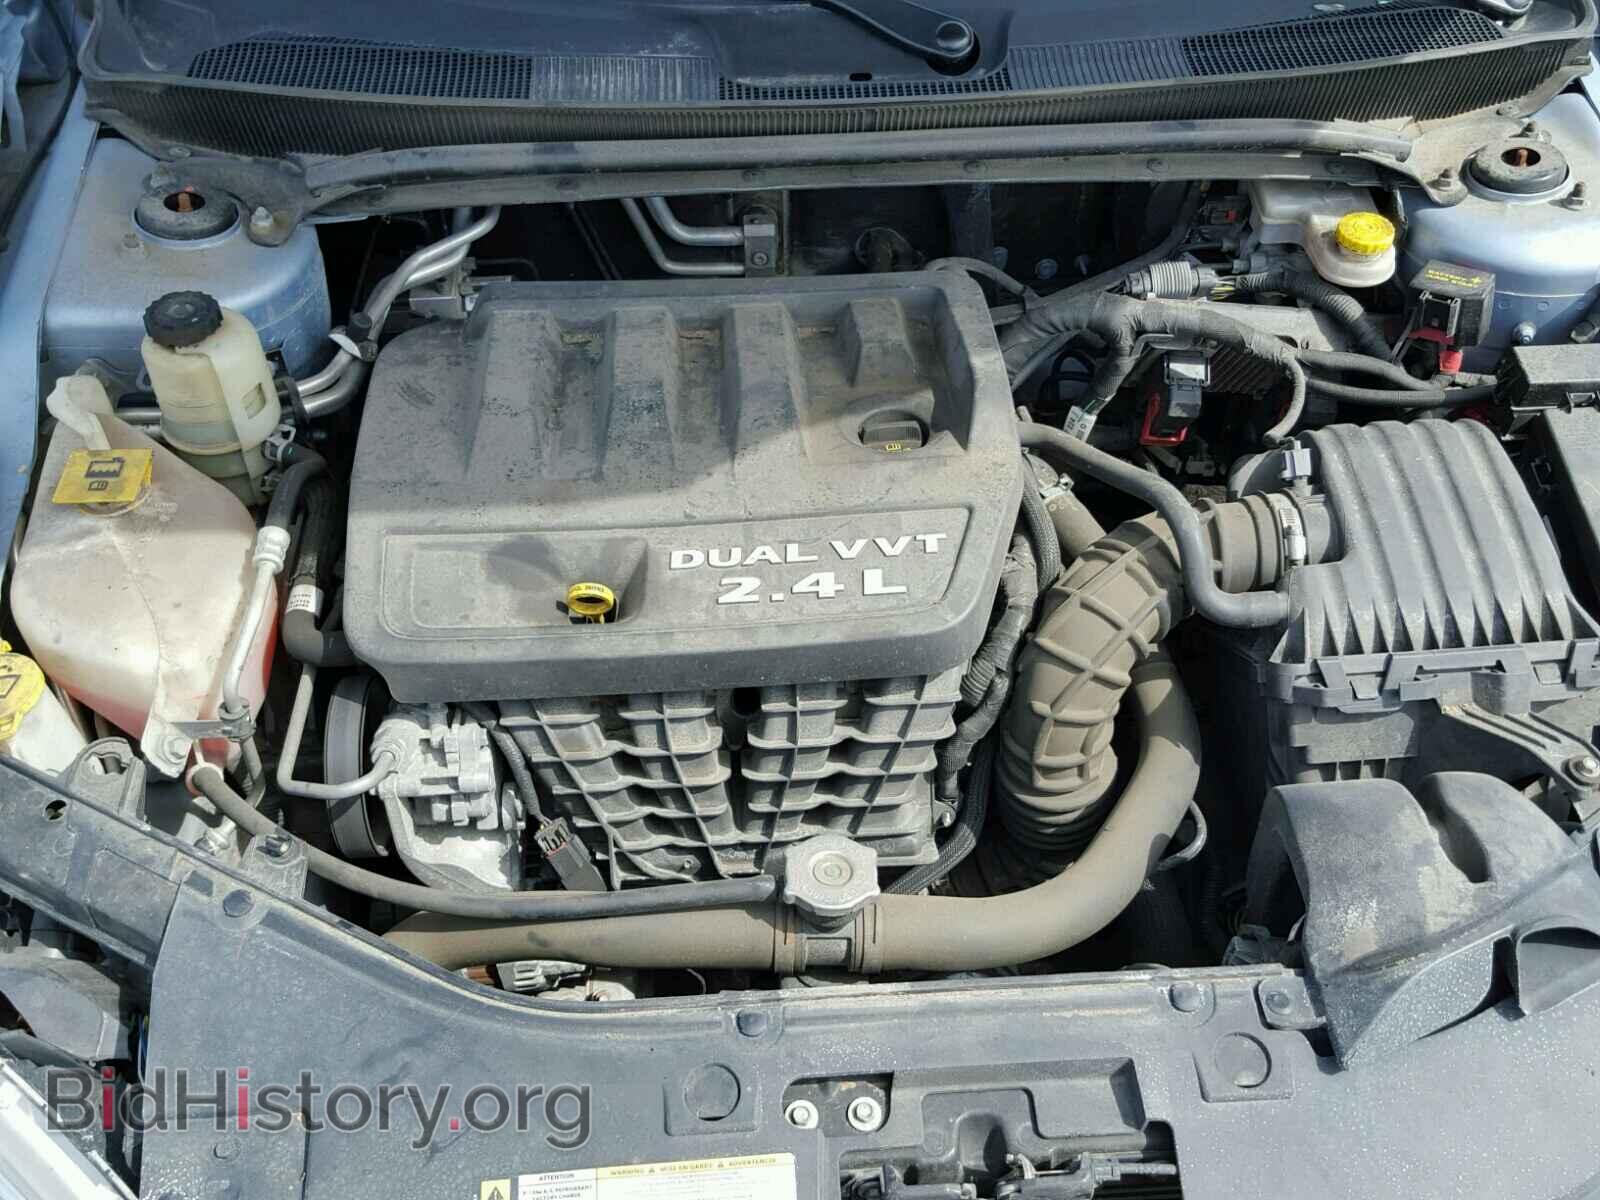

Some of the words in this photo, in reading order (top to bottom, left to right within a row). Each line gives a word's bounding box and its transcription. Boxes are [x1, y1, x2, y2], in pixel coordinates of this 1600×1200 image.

[669, 543, 819, 570] DUAL
[829, 533, 947, 559] VVT
[716, 571, 845, 605] 2.4
[862, 568, 907, 597] L
